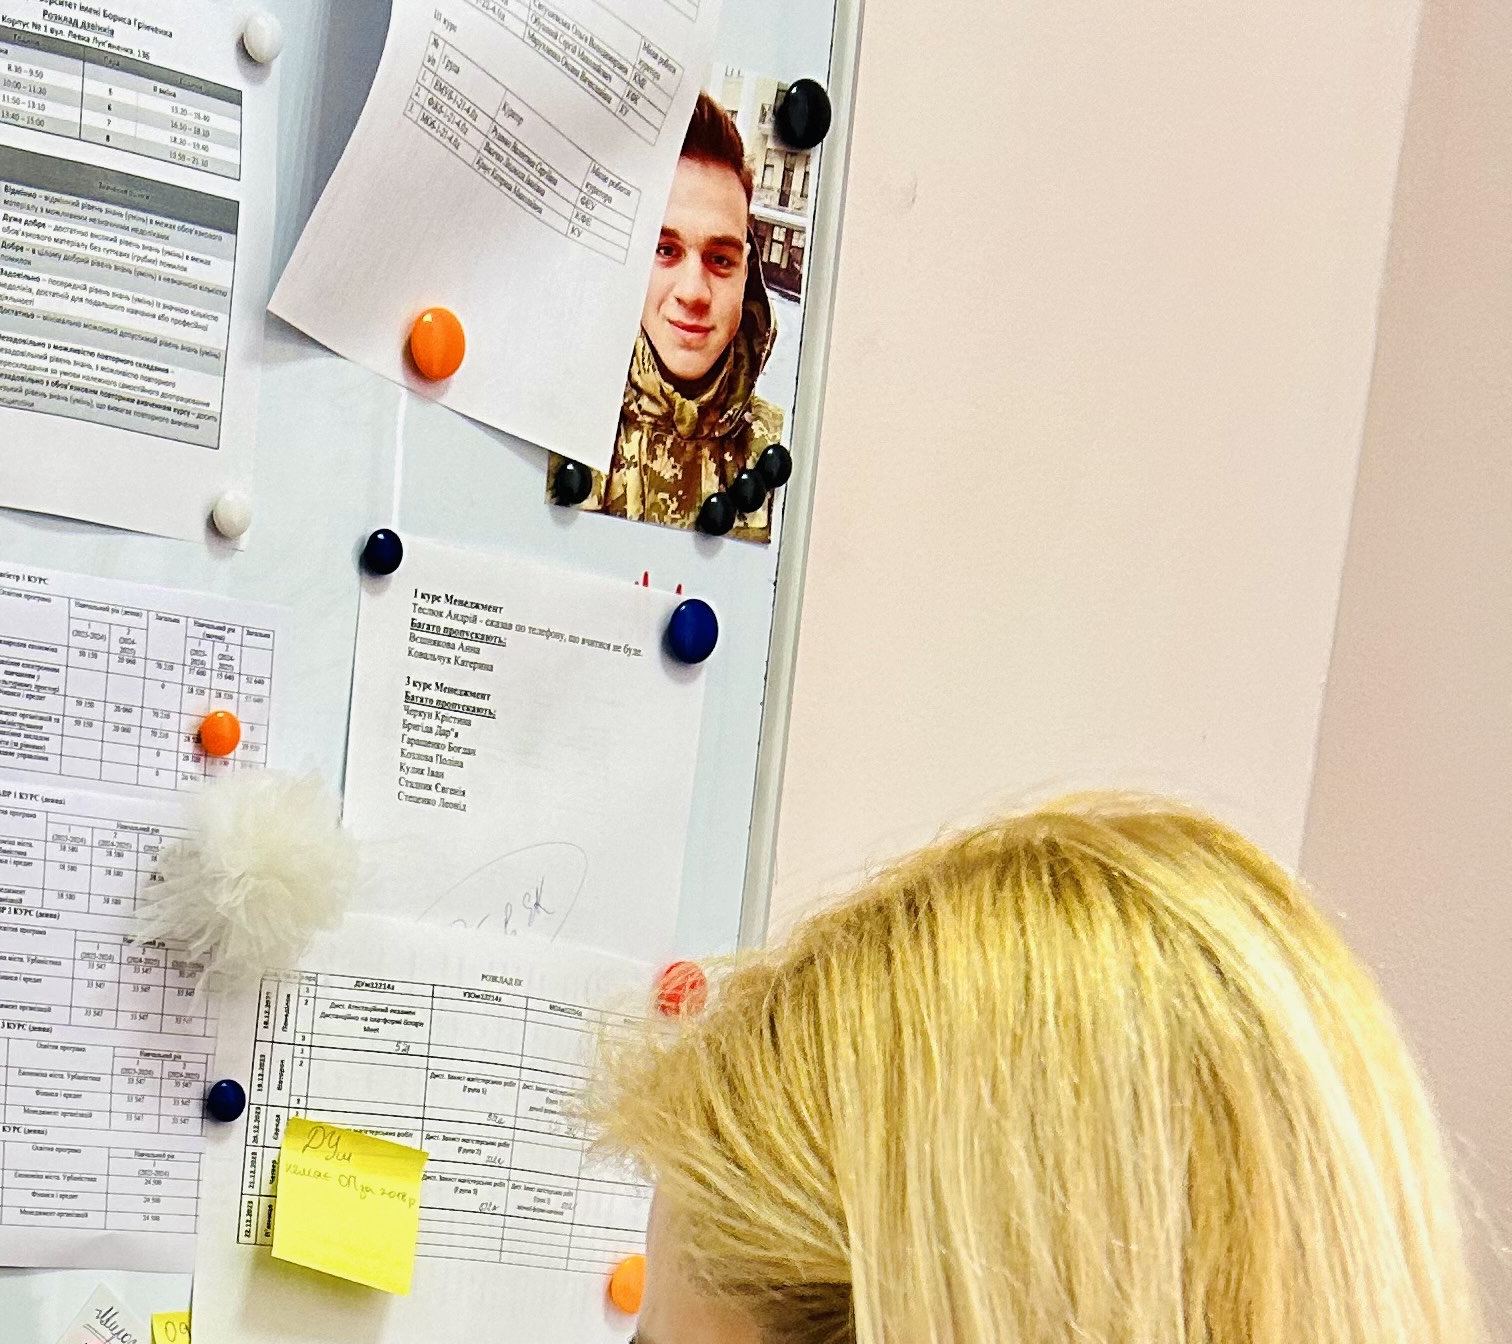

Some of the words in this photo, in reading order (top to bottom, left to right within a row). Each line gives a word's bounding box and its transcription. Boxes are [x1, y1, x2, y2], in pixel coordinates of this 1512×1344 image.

[421, 592, 442, 604] курс
[444, 594, 503, 614] Менеджмент
[446, 610, 477, 624] Андрій
[410, 618, 441, 633] Багато
[454, 656, 493, 672] Катерина
[413, 680, 432, 691] курс
[434, 682, 491, 701] Менеджмент
[404, 691, 433, 706] Багато
[19, 792, 39, 802] КУРС
